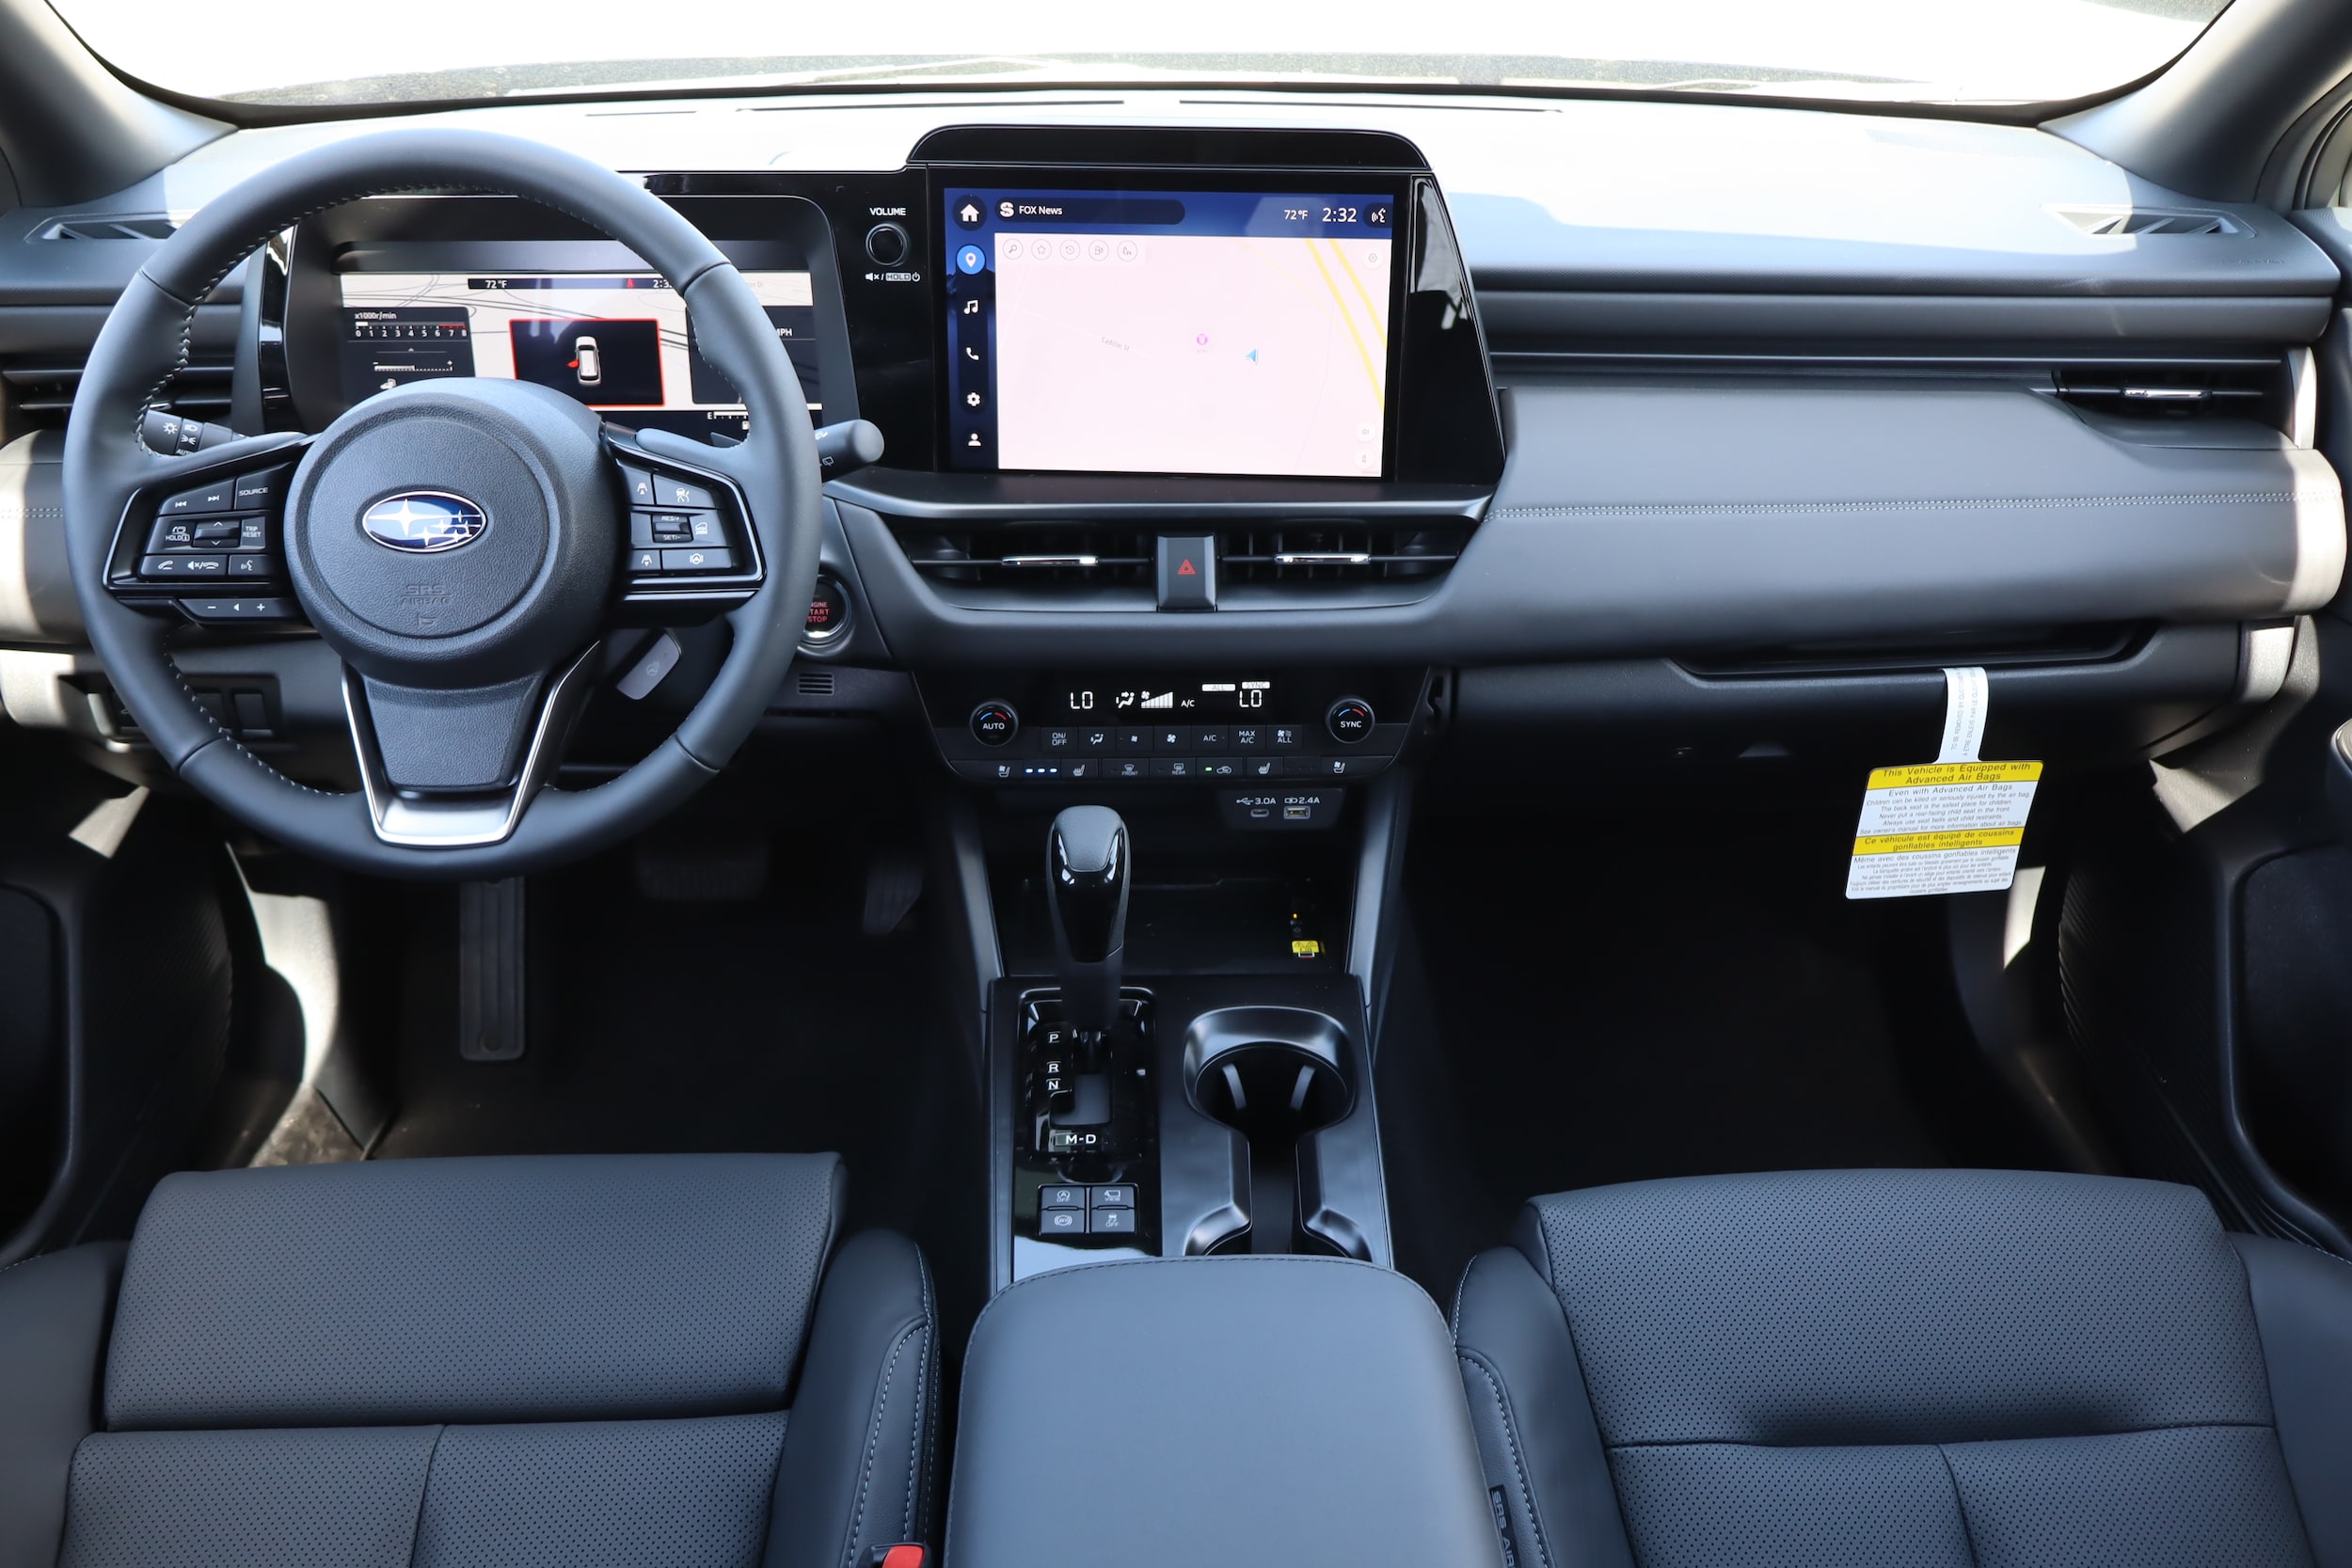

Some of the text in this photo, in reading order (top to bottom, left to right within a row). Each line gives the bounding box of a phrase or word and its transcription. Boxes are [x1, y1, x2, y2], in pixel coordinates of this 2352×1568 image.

[869, 207, 907, 216] VOLUME
[1018, 205, 1063, 215] FOX News
[1283, 209, 1309, 220] 72°F
[1322, 207, 1358, 223] 2:32
[886, 273, 911, 281] HOLD
[653, 279, 672, 289] 2:3
[355, 312, 397, 321] x1000r/min
[238, 487, 269, 497] SOURCE
[405, 584, 446, 594] SRS
[401, 596, 452, 605] AIRBAG
[1883, 769, 1902, 778] This
[1907, 767, 1942, 775] Vehicle
[1960, 763, 2007, 773] Equipped
[1905, 774, 1954, 784] Advanced
[1976, 772, 2001, 783] Bags
[1888, 783, 2012, 797] Even with Advanced Air Bags
[1880, 835, 1915, 844] véhicule
[1892, 839, 1983, 852] gonflables intelligents
[1911, 851, 1941, 860] coussins
[1943, 849, 1978, 859] gonflables
[1979, 847, 2016, 857] intelligents
[1049, 1034, 1059, 1044] P
[1048, 1063, 1059, 1073] R
[1048, 1080, 1059, 1091] N
[1493, 1491, 1507, 1529] SRS
[1502, 1536, 1516, 1568] AIR
